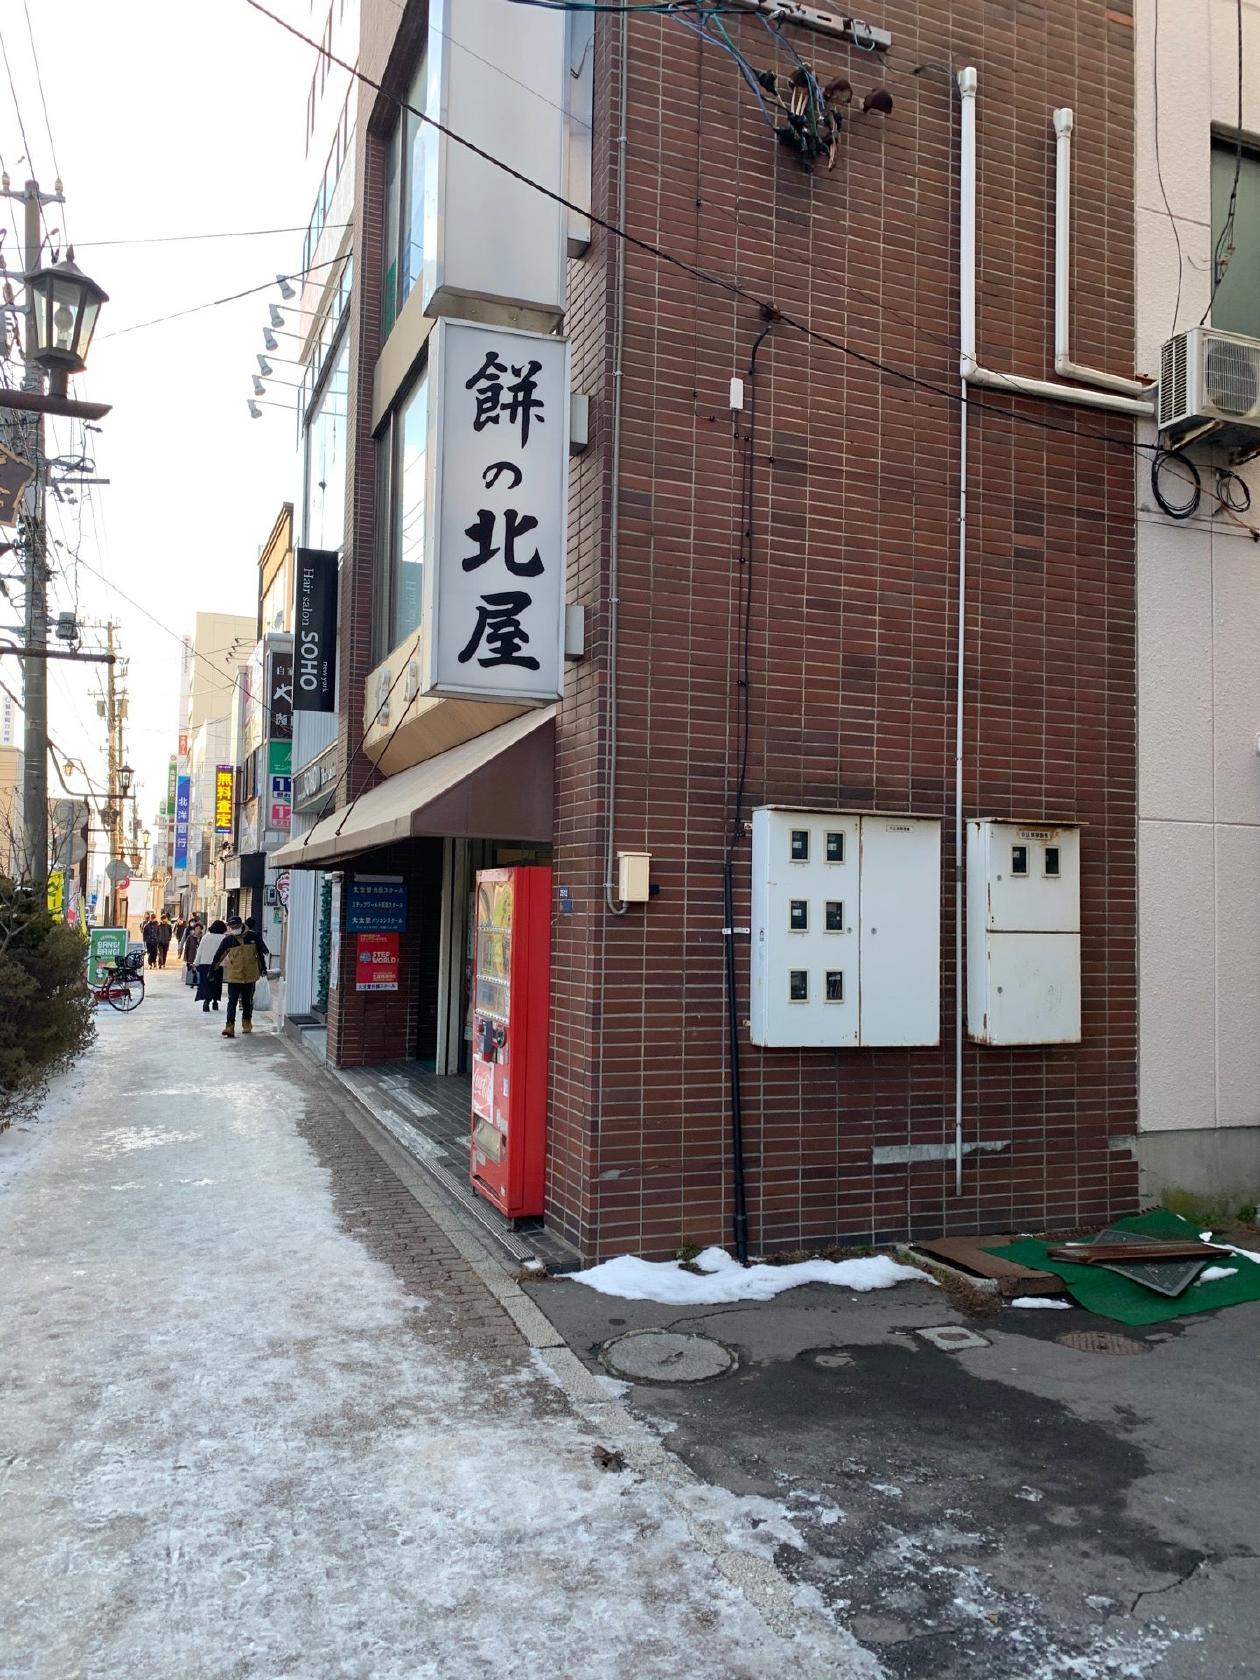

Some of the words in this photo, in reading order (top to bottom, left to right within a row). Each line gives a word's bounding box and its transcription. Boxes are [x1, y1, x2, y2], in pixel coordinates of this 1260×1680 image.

[458, 351, 545, 671] 餅の北屋
[303, 568, 314, 594] Hair
[302, 596, 313, 626] salon
[300, 631, 319, 691] SOHO
[216, 773, 233, 827] 無料査定
[97, 941, 120, 949] BANG!
